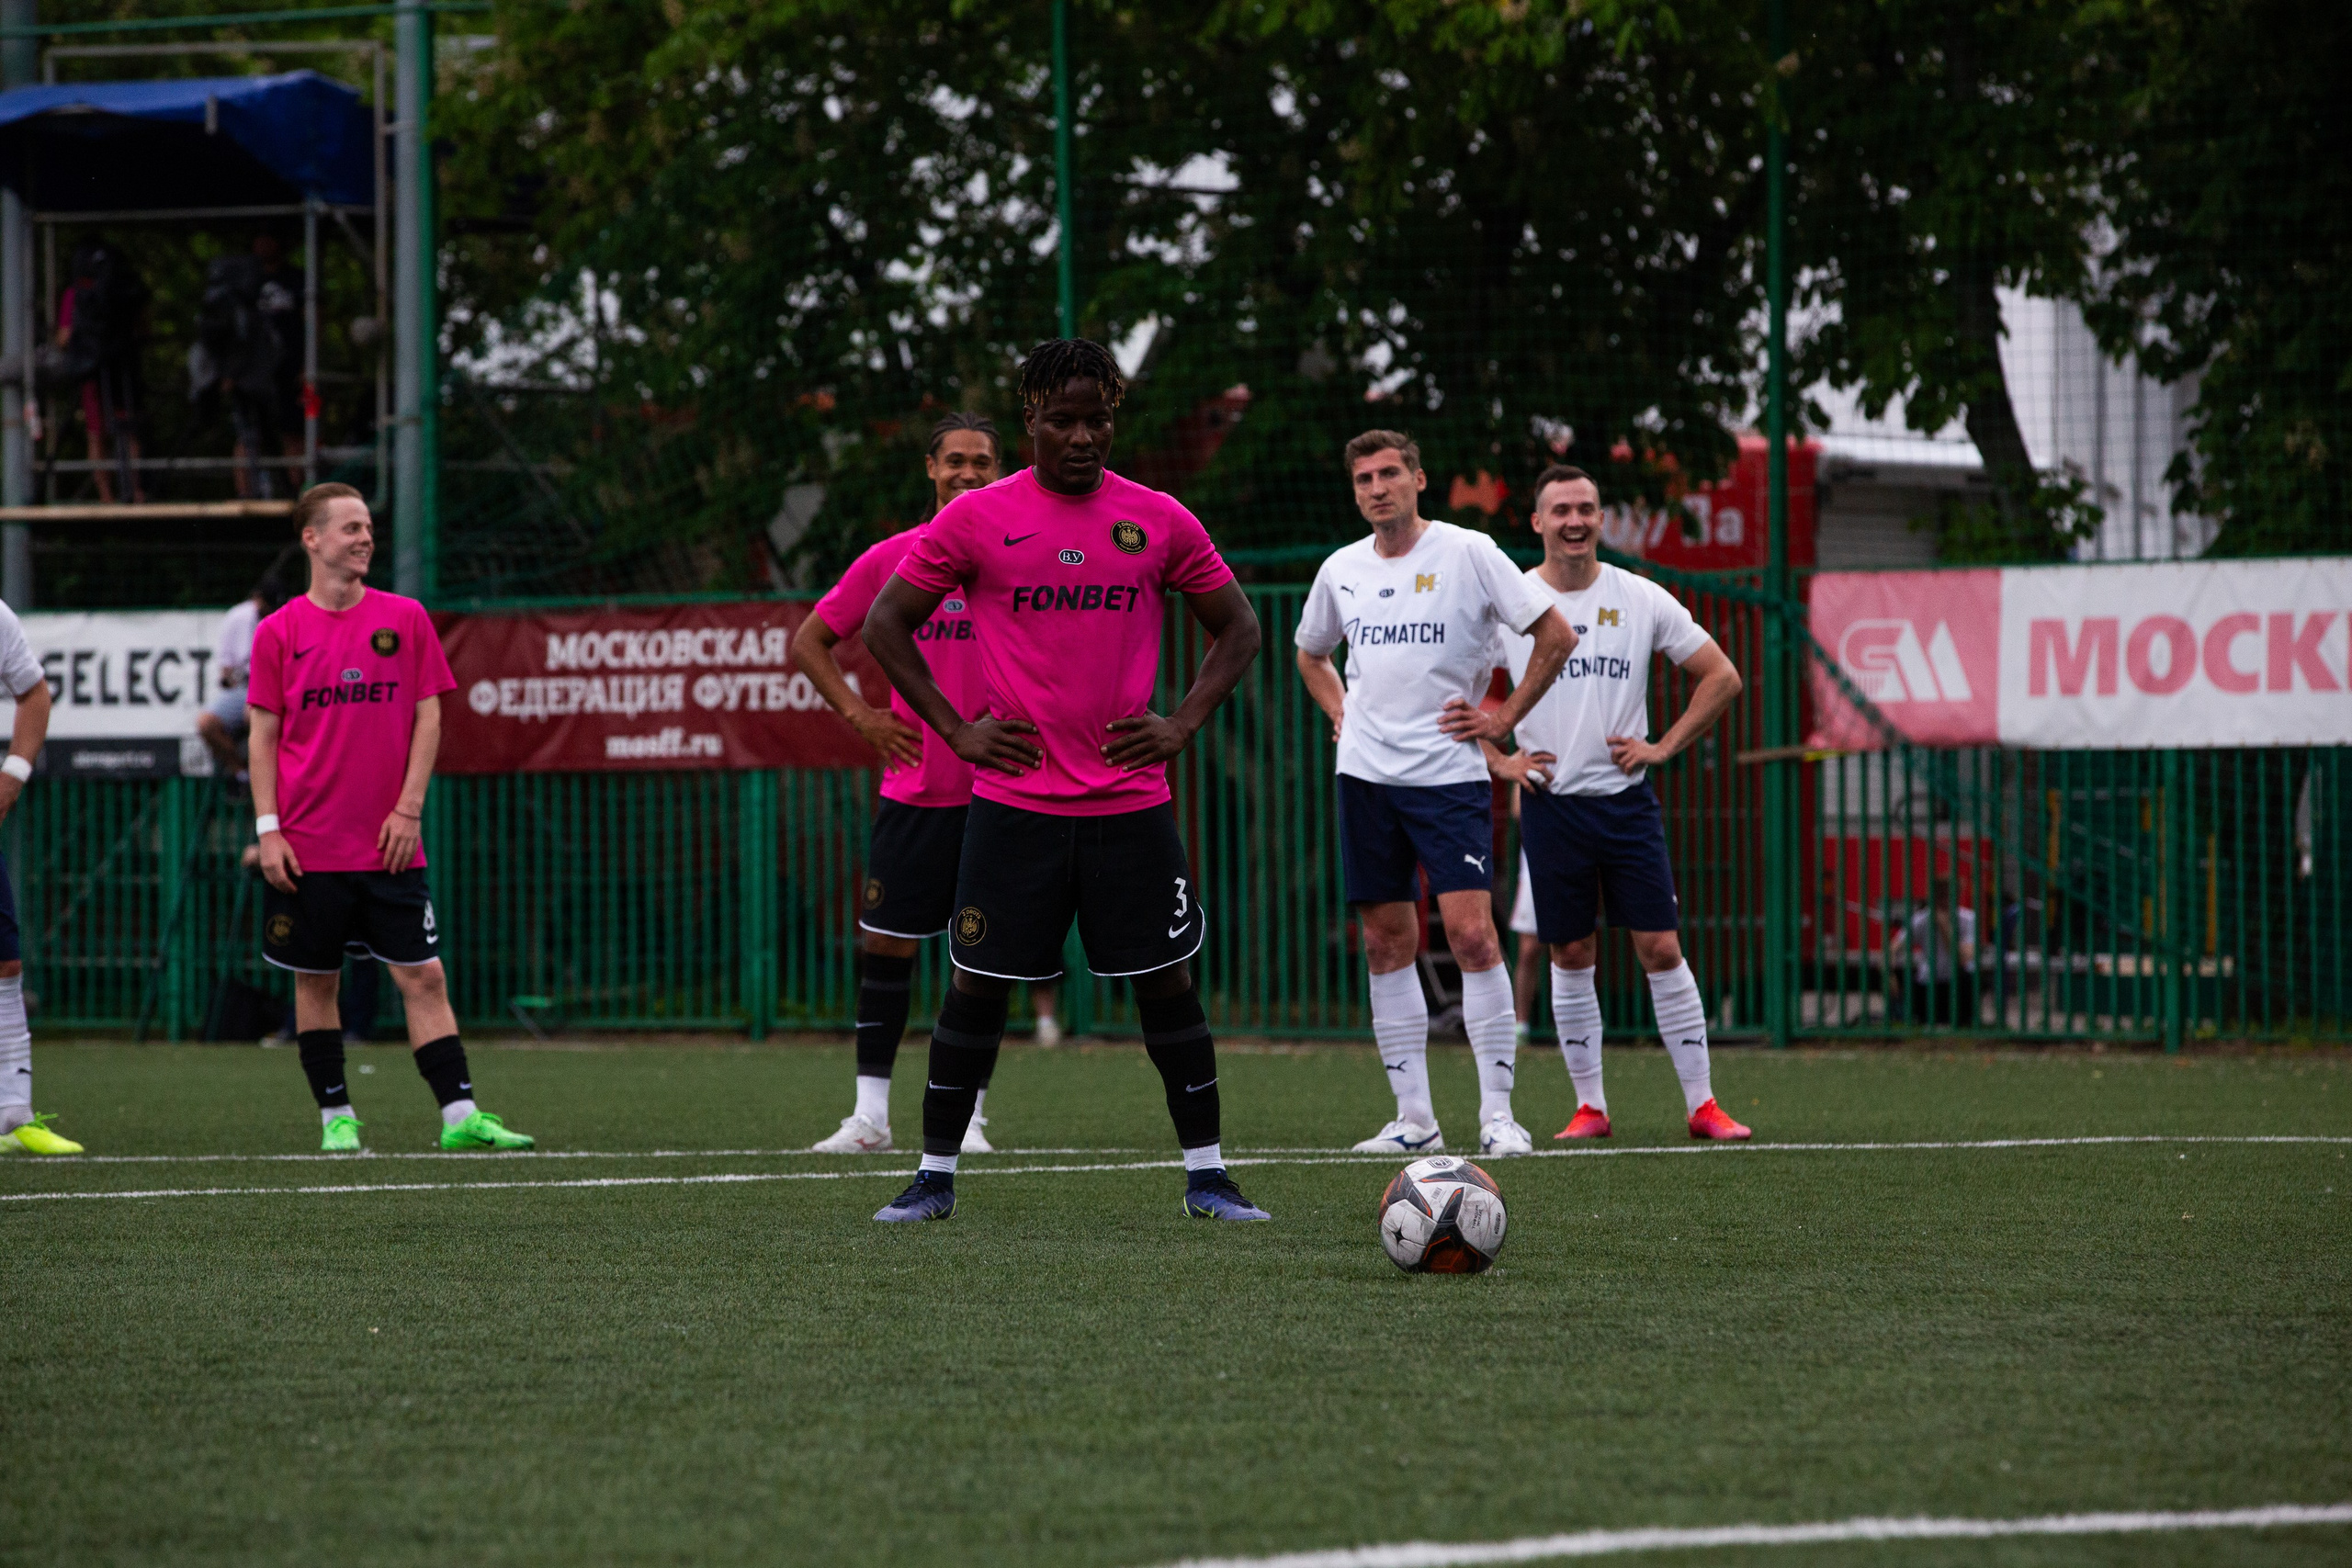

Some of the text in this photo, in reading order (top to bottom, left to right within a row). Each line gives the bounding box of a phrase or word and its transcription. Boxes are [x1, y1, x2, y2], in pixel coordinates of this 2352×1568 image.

[1013, 585, 1139, 612] FONBET
[547, 626, 787, 670] МОСКОВСКАЯ
[917, 620, 977, 641] ONB
[1361, 623, 1445, 645] FCMATCH
[2029, 610, 2352, 697] МОСК
[41, 649, 212, 705] SELECT
[301, 682, 399, 710] FONBET
[468, 673, 684, 723] ФЕДЕРАЦИЯ
[1174, 877, 1187, 918] 3
